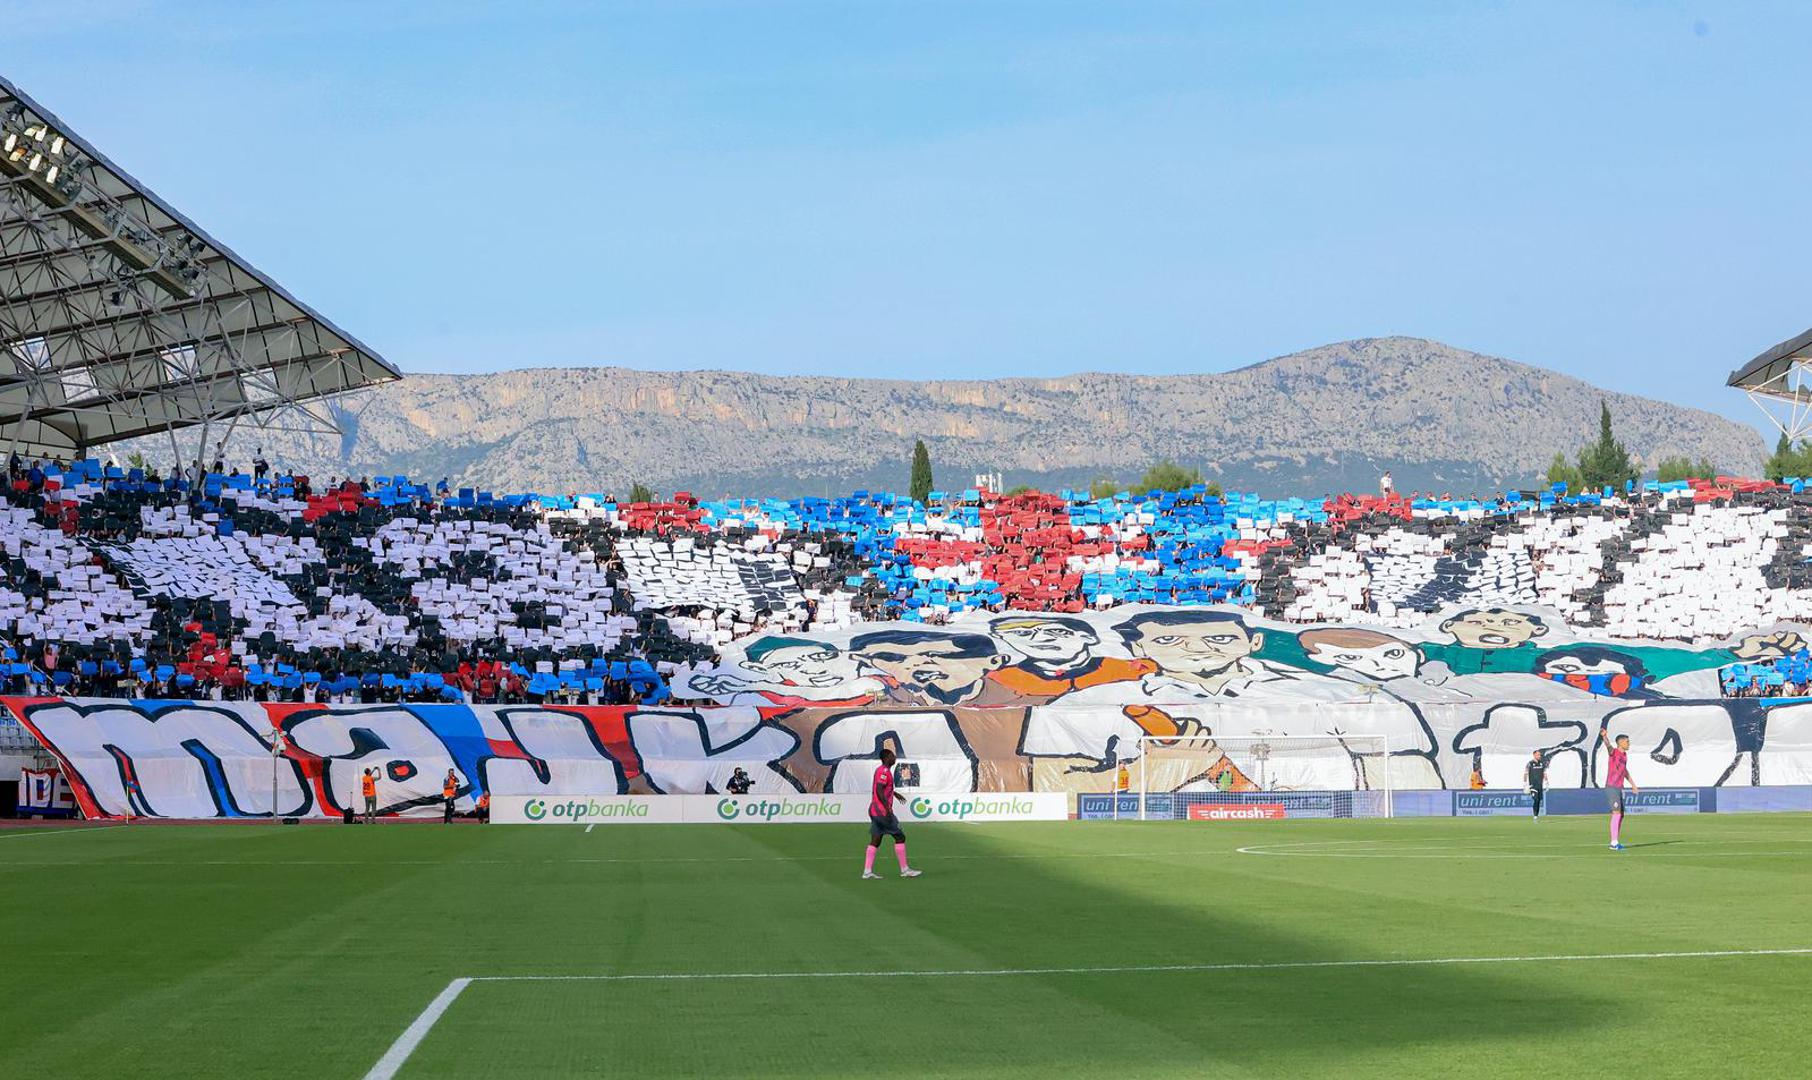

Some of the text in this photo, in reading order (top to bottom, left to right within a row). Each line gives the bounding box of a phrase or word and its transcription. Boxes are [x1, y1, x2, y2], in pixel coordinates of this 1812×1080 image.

[1086, 799, 1110, 811] uni
[1461, 795, 1484, 807] uni
[1487, 795, 1517, 807] rent
[1624, 793, 1639, 805] ni
[1642, 794, 1672, 805] rent
[1209, 806, 1265, 819] aircash
